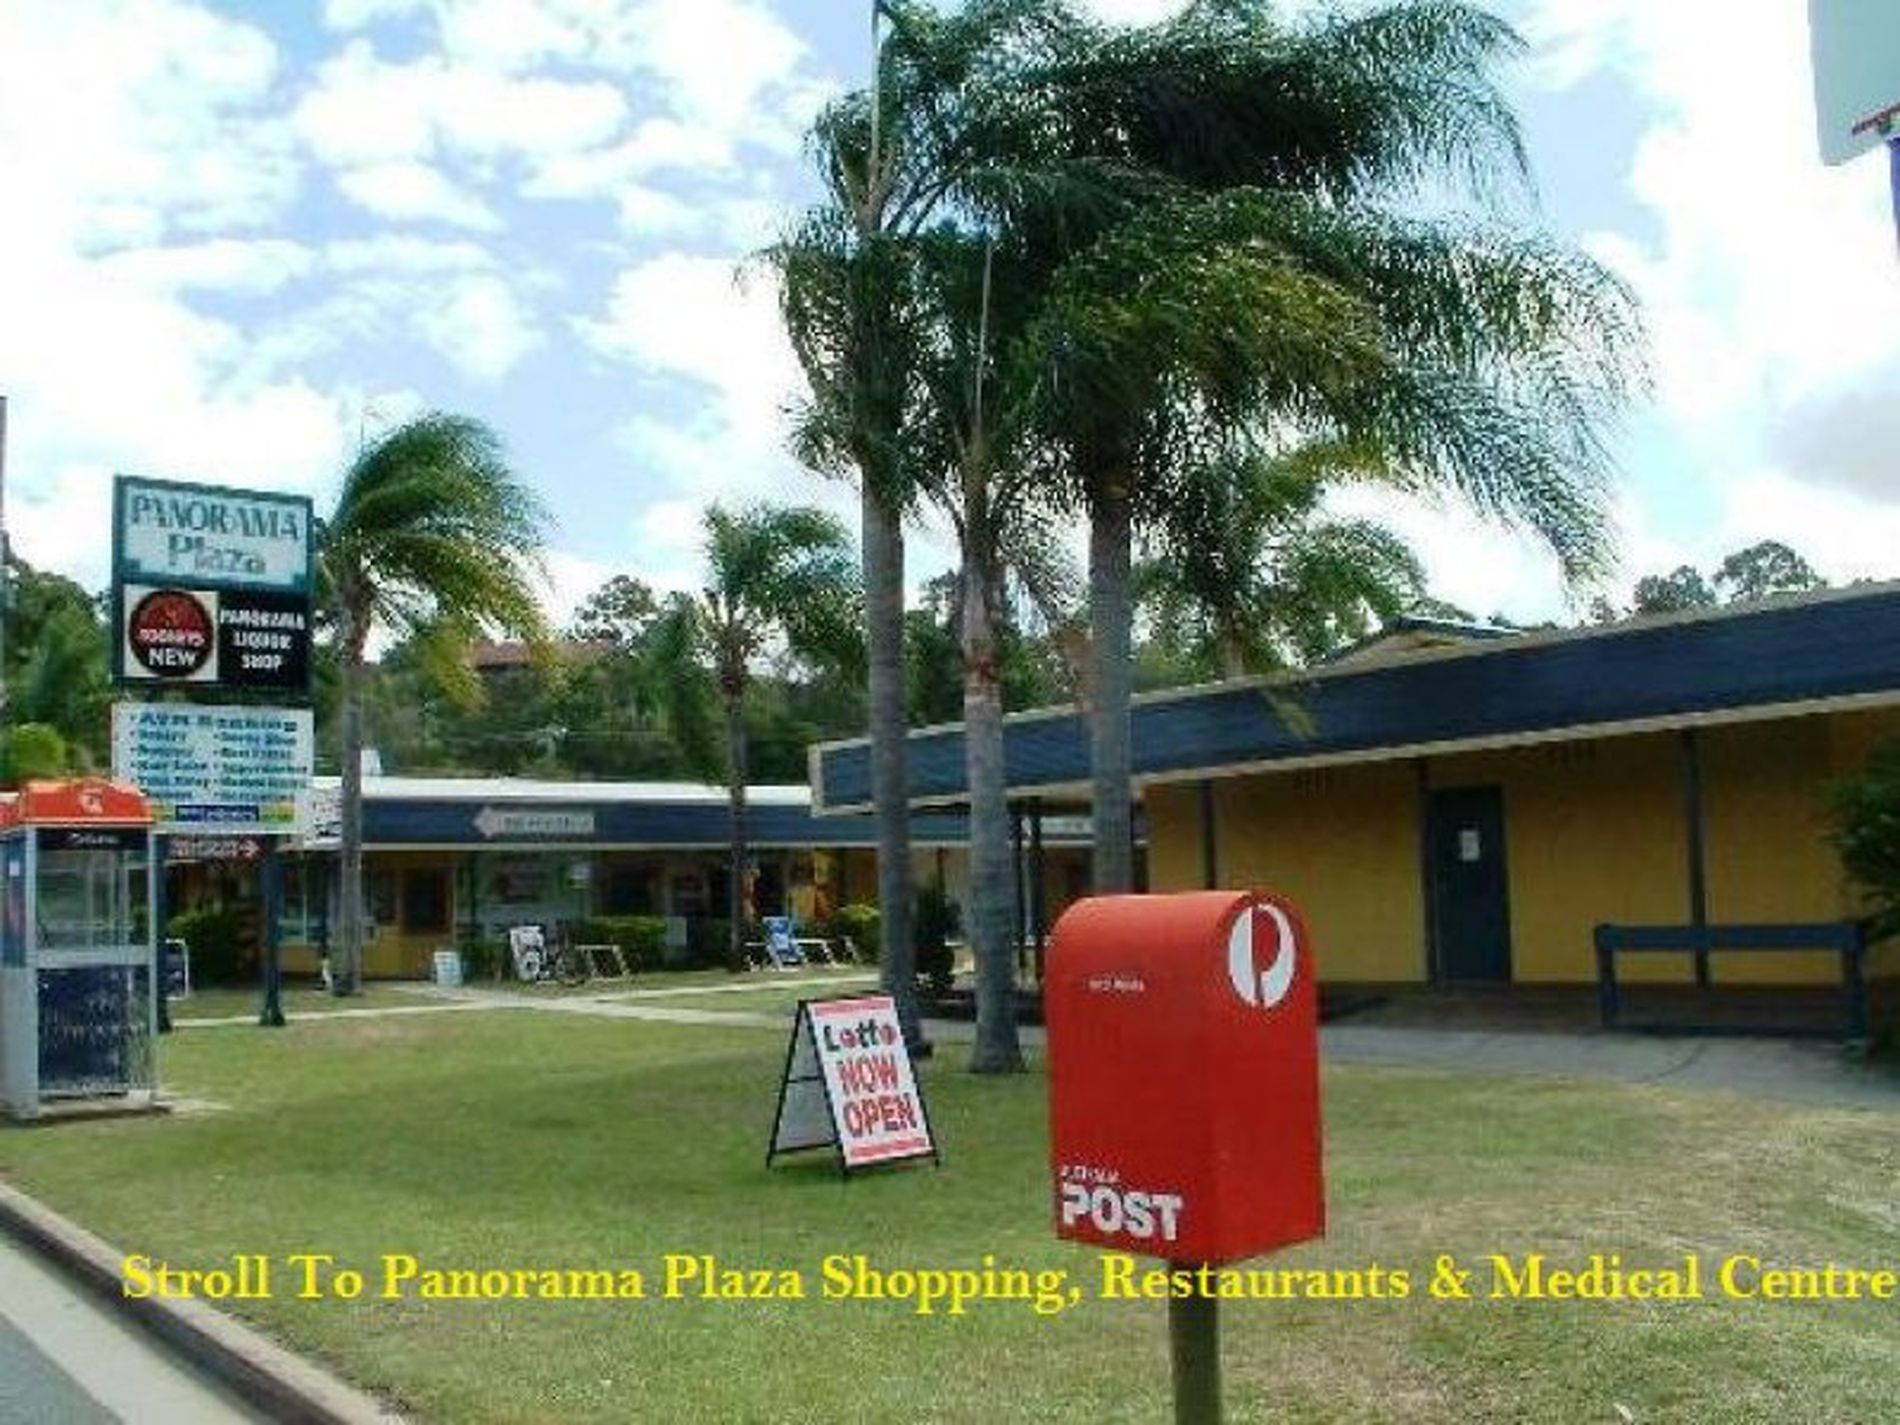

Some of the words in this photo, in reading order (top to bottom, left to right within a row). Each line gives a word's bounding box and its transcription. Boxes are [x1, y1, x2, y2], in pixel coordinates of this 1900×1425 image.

[133, 494, 299, 541] PANORAMA
[168, 533, 266, 574] Plaza
[148, 647, 197, 666] NEW
[241, 653, 283, 671] SHOP
[838, 1053, 900, 1094] NOW
[843, 1092, 918, 1138] OPEN
[1062, 1181, 1183, 1241] POST
